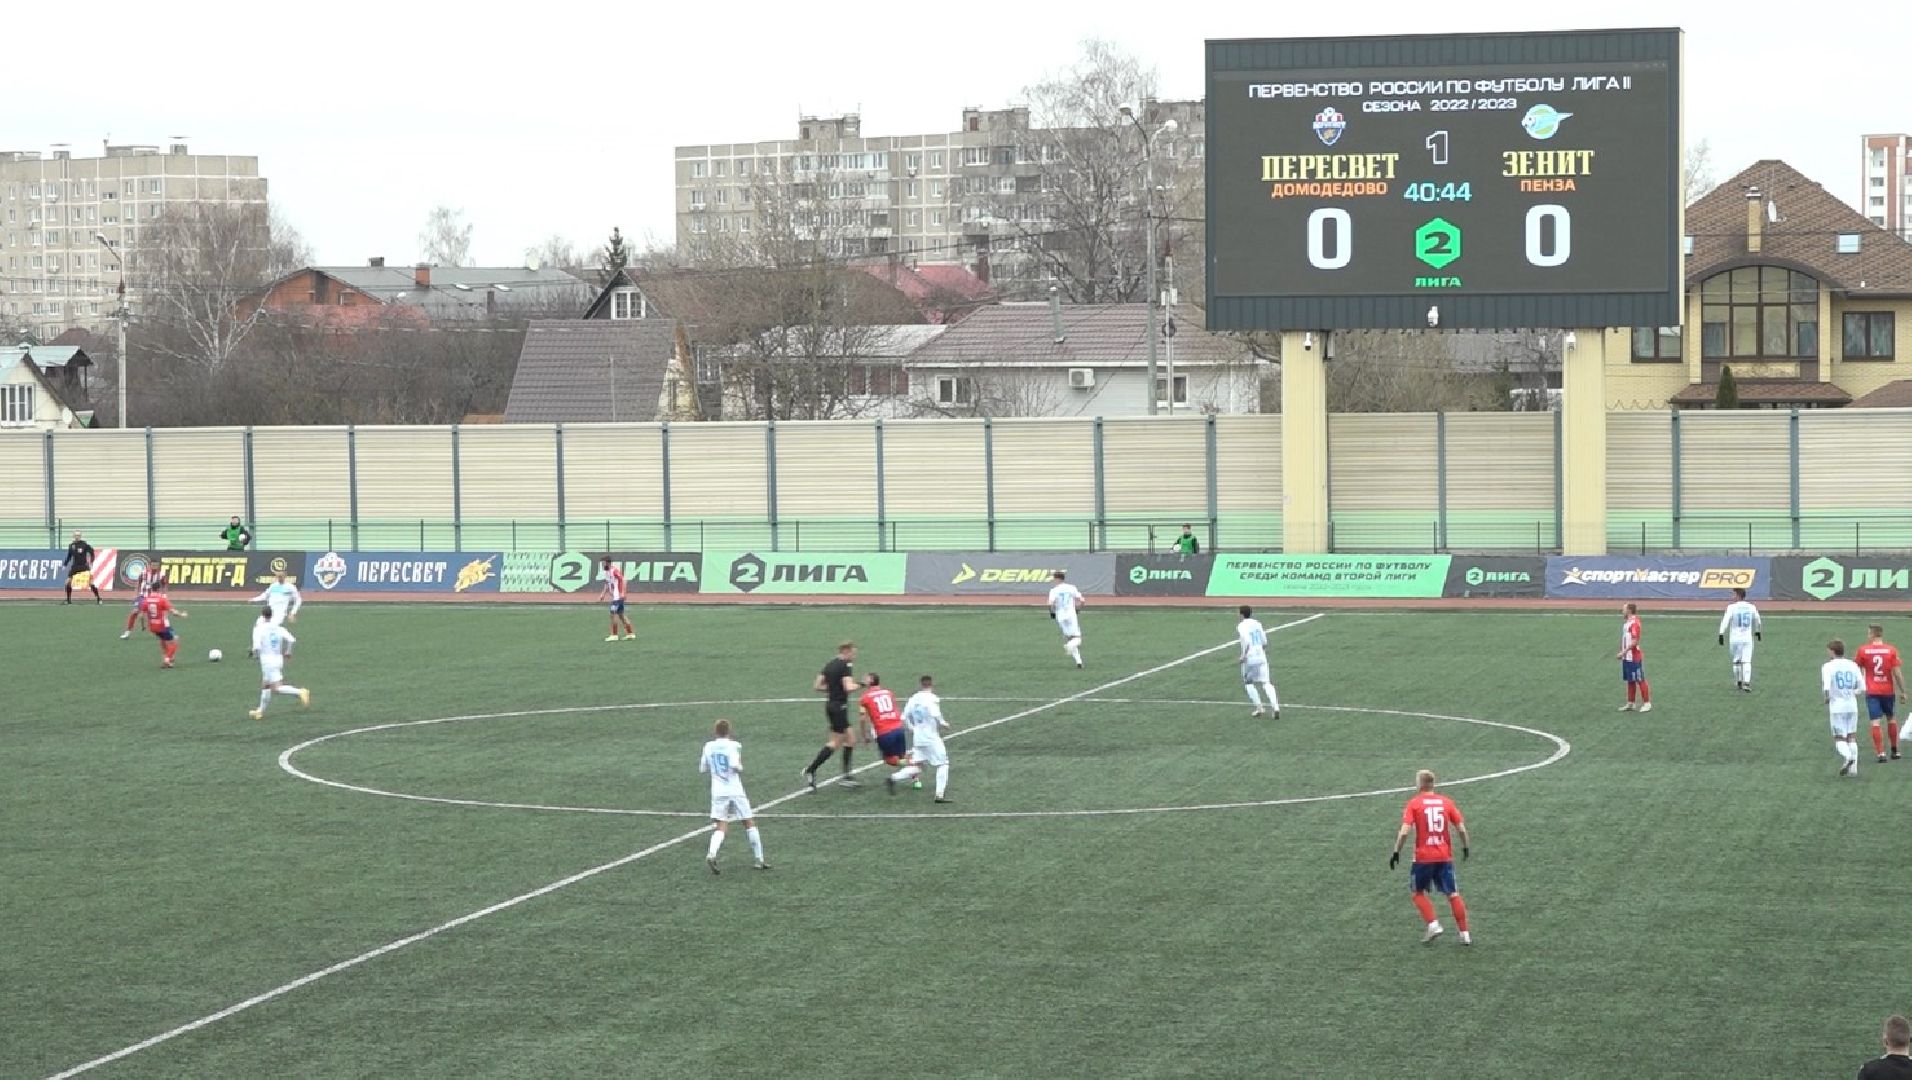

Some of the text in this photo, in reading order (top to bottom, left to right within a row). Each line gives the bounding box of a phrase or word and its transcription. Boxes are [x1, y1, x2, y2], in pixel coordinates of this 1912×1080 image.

[1248, 82, 1363, 98] ПЕРВЕНСТВО
[1369, 80, 1443, 95] РОССИИ
[1446, 79, 1471, 94] ПО
[1475, 76, 1565, 93] ФУТБОЛУ
[1571, 76, 1620, 91] ЛИГА
[1362, 100, 1422, 112] СЕЗОНА
[1425, 130, 1449, 165] 1
[1261, 152, 1400, 182] ПЕРЕСВЕТ
[1502, 149, 1595, 177] ЗЕНИТ
[1271, 181, 1388, 198] ДОМОДЕДОВО
[1403, 182, 1472, 202] 40:44
[1520, 178, 1577, 192] ПЕНЗА
[1308, 207, 1352, 270] 0
[1424, 231, 1453, 255] 2
[1525, 204, 1571, 267] 0
[1414, 276, 1462, 288] ЛИГА
[357, 561, 447, 583] ПЕРЕСВЕТ
[559, 561, 584, 580] 2
[735, 562, 868, 583] 2 ЛИГА
[1148, 569, 1192, 580] ЛИГА
[1226, 561, 1433, 570] ПЕРВЕНСТВО РОССИИ ПО ФУТБОЛУ
[160, 564, 245, 587] ГАРАНТ-Д
[1239, 570, 1417, 581] СРЕДИ КОМАНД ВТОРОЙ ЛИГИ
[1485, 570, 1531, 583] ЛИГА
[1704, 571, 1750, 585] PRO
[1811, 569, 1835, 588] 2
[1736, 612, 1751, 628] 15
[1872, 654, 1884, 675] 2
[1835, 671, 1853, 689] 69
[873, 694, 893, 713] 10
[711, 753, 729, 774] 19
[1424, 806, 1445, 833] 15
